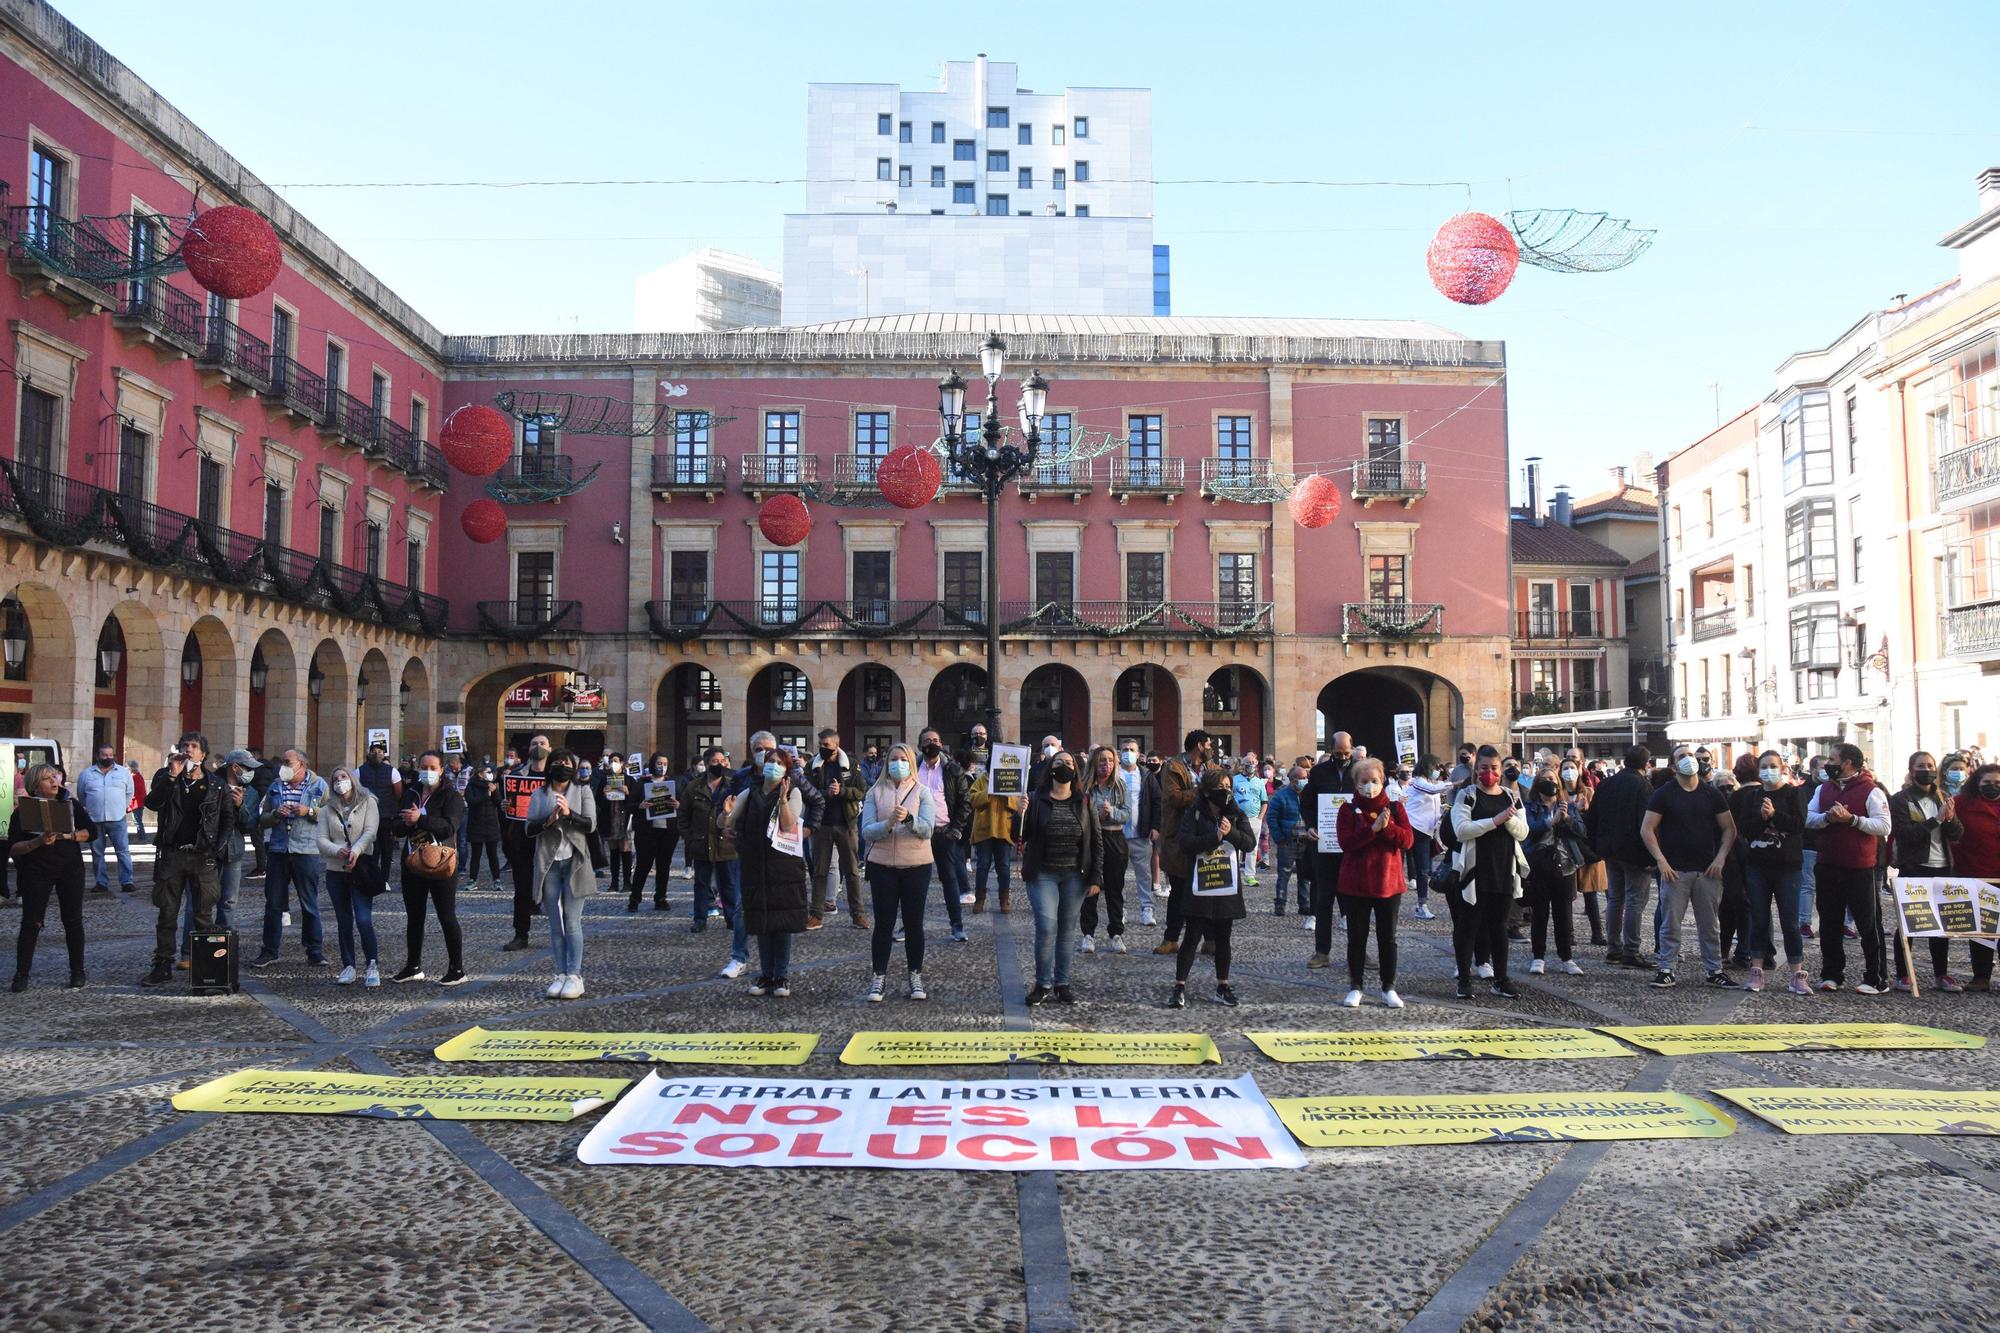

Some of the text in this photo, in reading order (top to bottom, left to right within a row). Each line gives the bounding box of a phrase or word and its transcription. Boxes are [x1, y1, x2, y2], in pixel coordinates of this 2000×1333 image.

[506, 689, 548, 701] MEDR
[506, 779, 516, 792] SE
[1942, 887, 1969, 896] suma
[322, 1083, 468, 1093] NUESTRO
[475, 1087, 602, 1096] FUTURO
[659, 1084, 1240, 1100] CERRAR LA HOSTELERÍA
[1304, 1101, 1667, 1113] POR NUESTRO FUTURO
[1820, 1096, 1980, 1106] NUESTRO
[672, 1103, 1223, 1128] NO ES LA
[1564, 1119, 1717, 1131] CERILLERO
[1782, 1118, 1935, 1127] MONTEVIL
[609, 1131, 1274, 1162] SOLUCIÓN
